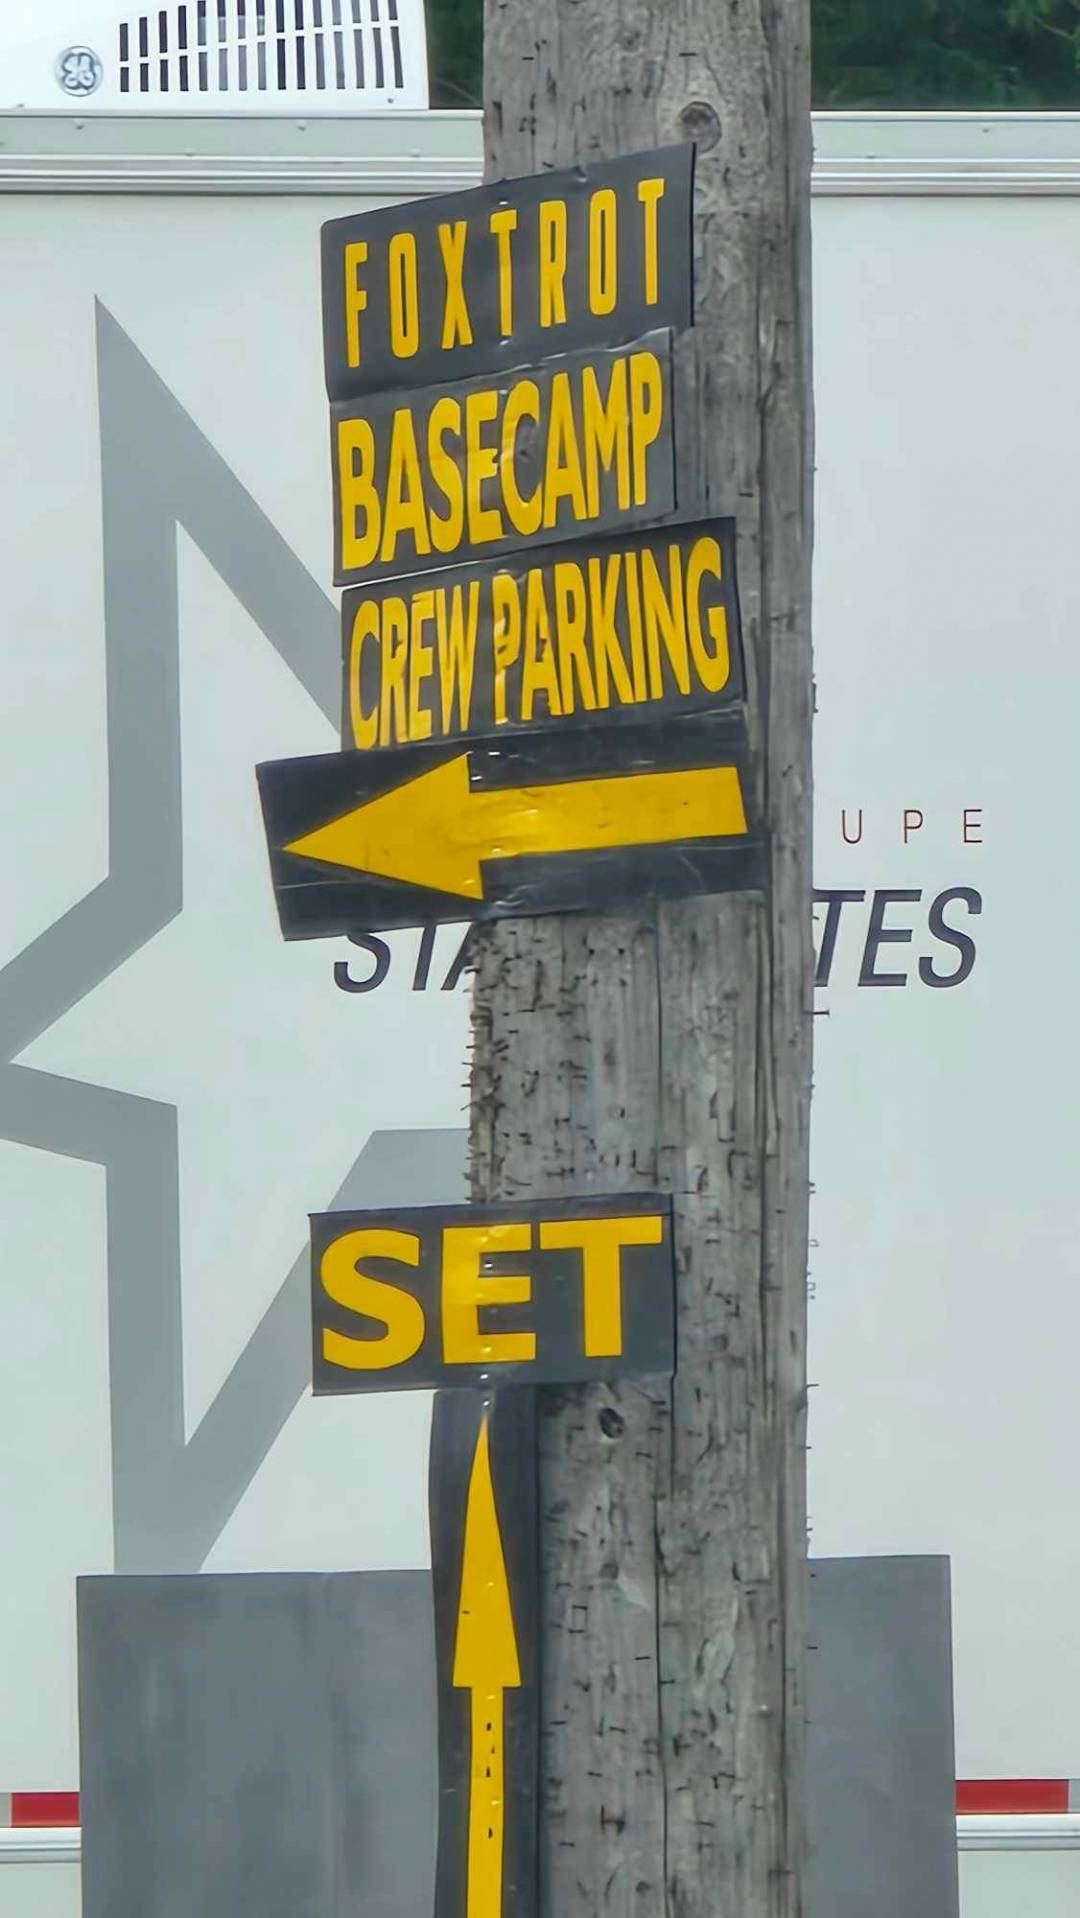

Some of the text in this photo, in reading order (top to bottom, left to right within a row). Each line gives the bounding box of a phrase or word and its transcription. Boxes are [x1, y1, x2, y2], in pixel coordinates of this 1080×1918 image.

[344, 178, 666, 369] FOXTROT
[336, 351, 664, 571] BASECAMP
[348, 536, 731, 751] CREW PARKING
[320, 1215, 664, 1370] SET
